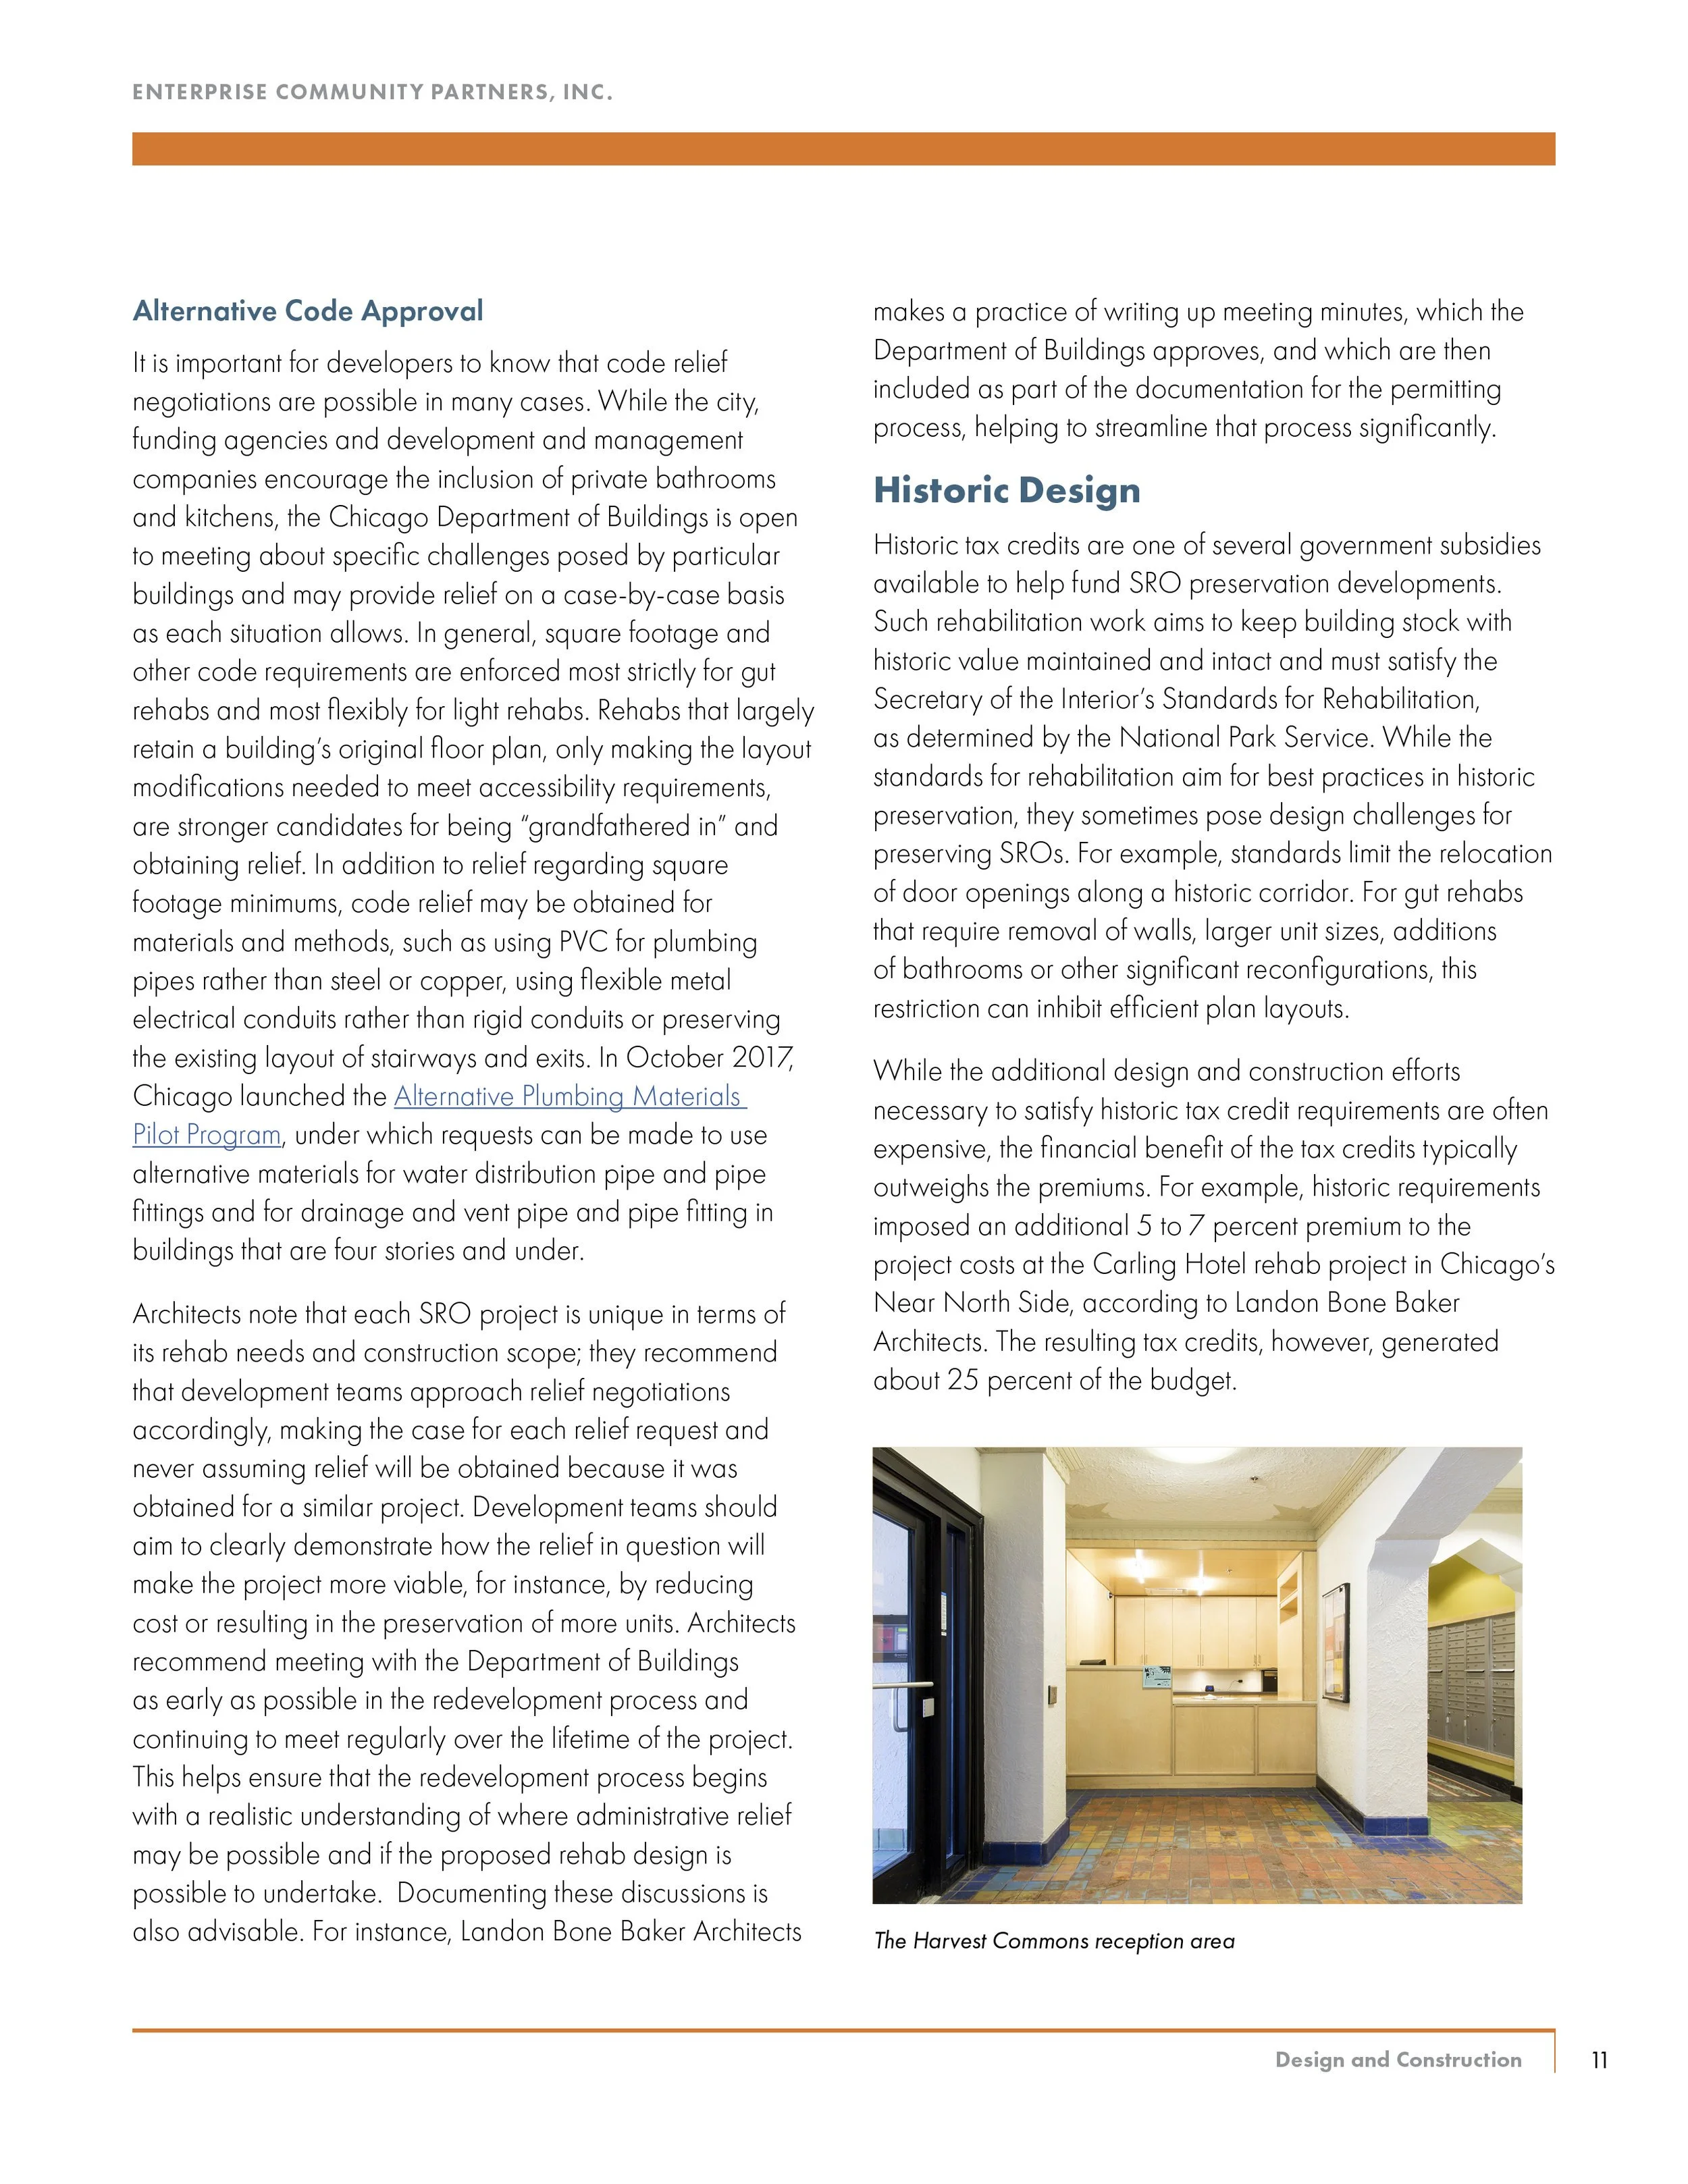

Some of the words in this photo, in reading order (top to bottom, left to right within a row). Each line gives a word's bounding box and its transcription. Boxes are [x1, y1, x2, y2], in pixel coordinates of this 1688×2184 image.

[133, 83, 267, 100] ENTERPRISE
[276, 83, 424, 100] COMMUNITY
[431, 83, 555, 103] PARTNERS,
[564, 83, 612, 101] INC.
[132, 298, 277, 322] Alternative
[285, 298, 353, 322] Code
[361, 298, 483, 328] Approval
[874, 298, 945, 322] makes
[953, 307, 966, 322] a
[976, 302, 1067, 329] practice
[1075, 297, 1098, 322] of
[1103, 302, 1178, 328] writing
[1188, 307, 1215, 329] up
[1223, 302, 1312, 329] meeting
[1321, 302, 1408, 325] minutes,
[1416, 298, 1483, 322] which
[1491, 298, 1524, 322] the
[134, 350, 146, 373] It
[153, 353, 168, 373] is
[176, 353, 282, 380] important
[289, 348, 319, 373] for
[327, 349, 453, 380] developers
[460, 354, 481, 373] to
[490, 349, 551, 373] know
[558, 349, 600, 373] that
[607, 349, 666, 373] code
[675, 348, 729, 373] relief
[875, 474, 1009, 504] Historic
[1020, 474, 1140, 512] Design
[875, 533, 959, 556] Historic
[965, 536, 999, 556] tax
[1007, 531, 1080, 556] credits
[1088, 540, 1124, 556] are
[1132, 540, 1176, 556] one
[1184, 531, 1206, 556] of
[1212, 531, 1291, 556] several
[1300, 536, 1433, 562] government
[1440, 531, 1541, 556] subsidies
[133, 658, 191, 682] other
[198, 658, 257, 682] code
[265, 662, 407, 689] requirements
[415, 666, 452, 682] are
[460, 657, 560, 682] enforced
[569, 662, 621, 682] most
[627, 658, 697, 689] strictly
[703, 657, 734, 682] for
[741, 662, 776, 689] gut
[874, 686, 983, 716] Secretary
[990, 685, 1013, 710] of
[1020, 685, 1053, 710] the
[1163, 685, 1277, 710] Standards
[1285, 685, 1315, 710] for
[1324, 685, 1479, 714] Rehabilitation,
[133, 821, 169, 836] are
[178, 818, 269, 843] stronger
[277, 813, 402, 836] candidates
[409, 812, 440, 836] for
[448, 813, 511, 843] being
[735, 813, 777, 836] and
[874, 844, 991, 870] preserving
[1000, 841, 1070, 864] SROs.
[1079, 841, 1113, 864] For
[1120, 840, 1222, 870] example,
[1231, 840, 1341, 864] standards
[1350, 840, 1391, 863] limit
[1398, 840, 1431, 864] the
[1440, 840, 1552, 864] relocation
[132, 1044, 166, 1068] the
[175, 1048, 257, 1075] existing
[266, 1044, 335, 1075] layout
[342, 1044, 365, 1068] of
[371, 1048, 477, 1075] stairways
[484, 1044, 527, 1068] and
[536, 1048, 591, 1068] exits.
[600, 1046, 617, 1068] In
[627, 1044, 724, 1068] October
[733, 1045, 794, 1072] 2017,
[873, 1057, 942, 1082] While
[950, 1057, 983, 1082] the
[991, 1057, 1105, 1082] additional
[1114, 1057, 1188, 1088] design
[1197, 1057, 1240, 1082] and
[1249, 1061, 1383, 1082] construction
[1392, 1057, 1460, 1082] efforts
[874, 1213, 970, 1243] imposed
[978, 1221, 1006, 1236] an
[1015, 1213, 1128, 1236] additional
[1136, 1214, 1152, 1236] 5
[1160, 1217, 1182, 1237] to
[1189, 1214, 1206, 1236] 7
[1214, 1217, 1298, 1243] percent
[1307, 1217, 1401, 1243] premium
[1408, 1217, 1430, 1236] to
[1438, 1213, 1471, 1236] the
[134, 1237, 234, 1268] buildings
[241, 1237, 282, 1261] that
[290, 1246, 327, 1261] are
[334, 1236, 377, 1261] four
[385, 1241, 455, 1261] stories
[463, 1237, 505, 1261] and
[515, 1237, 584, 1261] under.
[132, 1300, 241, 1325] Architects
[249, 1305, 298, 1325] note
[305, 1300, 347, 1325] that
[354, 1300, 410, 1325] each
[419, 1301, 471, 1325] SRO
[481, 1304, 558, 1331] project
[566, 1304, 581, 1325] is
[589, 1304, 664, 1331] unique
[672, 1304, 689, 1324] in
[697, 1305, 756, 1325] terms
[764, 1300, 787, 1325] of
[874, 1366, 941, 1391] about
[948, 1367, 978, 1391] 25
[988, 1371, 1073, 1397] percent
[1080, 1366, 1103, 1391] of
[1109, 1366, 1142, 1391] the
[1151, 1366, 1237, 1397] budget.
[133, 1614, 178, 1634] cost
[185, 1618, 209, 1634] or
[217, 1609, 307, 1640] resulting
[316, 1614, 334, 1633] in
[342, 1609, 375, 1634] the
[384, 1614, 523, 1640] preservation
[531, 1609, 554, 1634] of
[561, 1618, 617, 1634] more
[626, 1614, 679, 1634] units.
[687, 1609, 796, 1634] Architects
[132, 1763, 174, 1788] This
[182, 1763, 241, 1794] helps
[248, 1772, 322, 1788] ensure
[329, 1763, 371, 1788] that
[377, 1763, 411, 1788] the
[420, 1763, 589, 1794] redevelopment
[598, 1772, 685, 1794] process
[693, 1763, 767, 1794] begins
[133, 1918, 180, 1942] also
[188, 1918, 304, 1942] advisable.
[313, 1919, 348, 1942] For
[355, 1922, 452, 1946] instance,
[462, 1918, 544, 1942] Landon
[554, 1919, 612, 1942] Bone
[621, 1918, 686, 1942] Baker
[693, 1918, 801, 1942] Architects
[875, 1929, 907, 1949] The
[914, 1931, 988, 1950] Harvest
[993, 1931, 1089, 1949] Commons
[1094, 1932, 1184, 1955] reception
[1190, 1937, 1236, 1949] area
[1276, 2050, 1344, 2073] Design
[1351, 2050, 1390, 2068] and
[1396, 2050, 1522, 2068] Construction
[1592, 2051, 1607, 2069] 11
